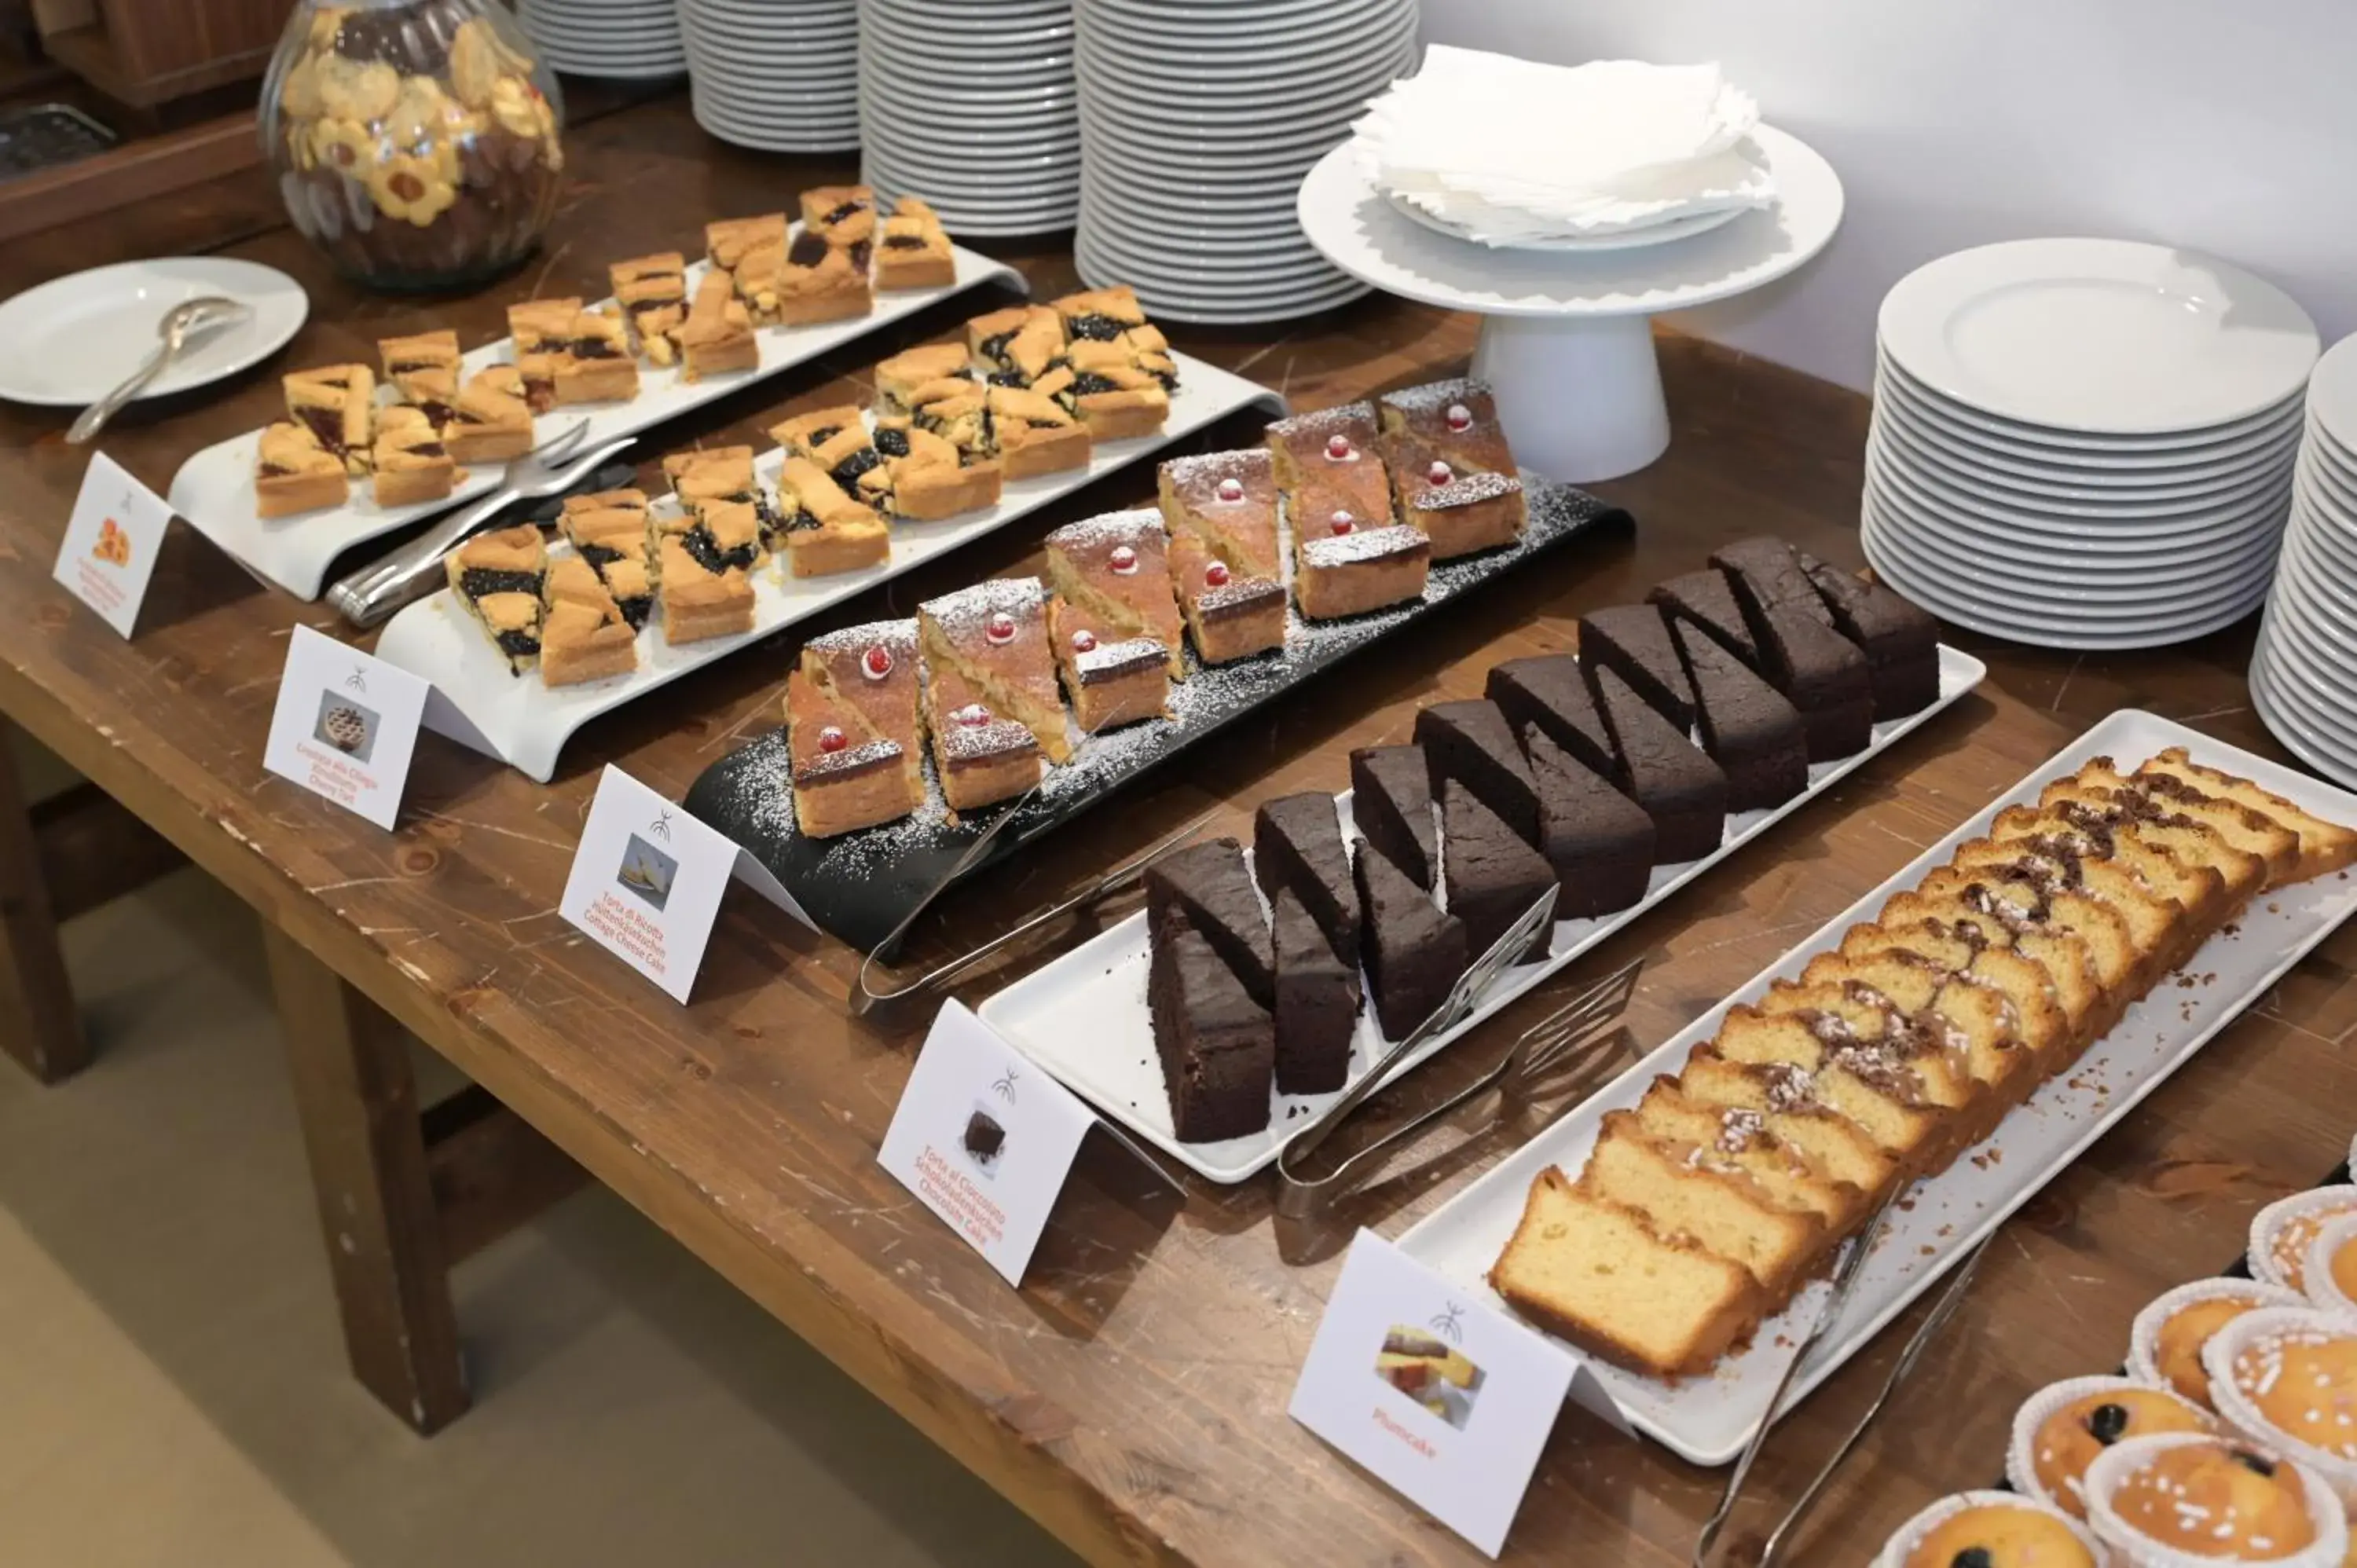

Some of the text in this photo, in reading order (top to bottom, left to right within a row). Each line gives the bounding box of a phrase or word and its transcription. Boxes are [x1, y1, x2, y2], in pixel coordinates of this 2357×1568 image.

[584, 909, 666, 974] Cottage Cheese Cake
[603, 891, 625, 914] Torta
[635, 915, 664, 941] Ricotta
[924, 1145, 948, 1173] Torta
[948, 1168, 961, 1183] al
[914, 1156, 1003, 1243] Schokoladenkuchen
[919, 1178, 988, 1243] Chocolate Cake
[1372, 1407, 1437, 1459] Plumcake
